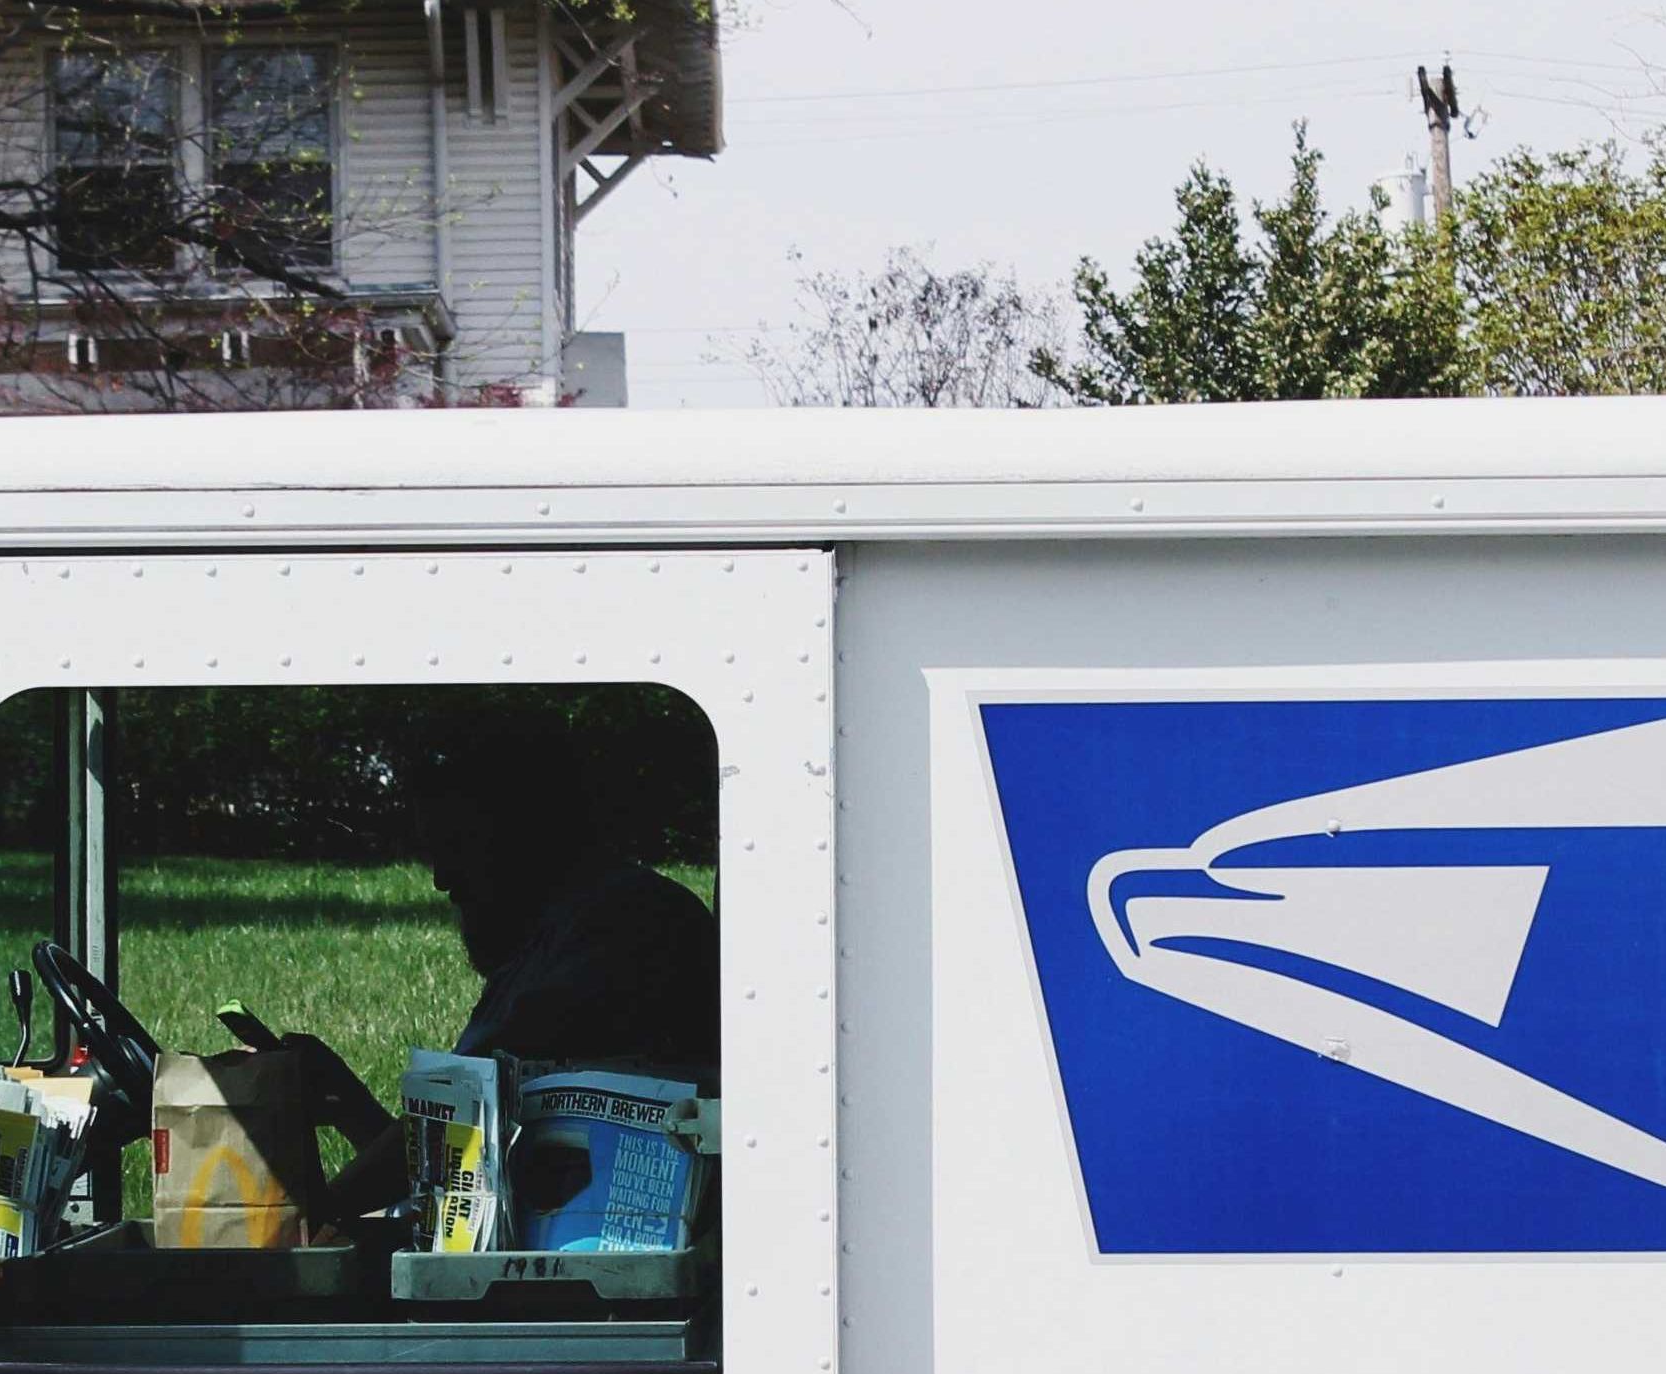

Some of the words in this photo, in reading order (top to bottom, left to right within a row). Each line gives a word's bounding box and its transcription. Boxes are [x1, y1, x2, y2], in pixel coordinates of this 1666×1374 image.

[541, 1093, 608, 1113] NORTHERN
[611, 1099, 666, 1125] BREWER
[619, 1133, 643, 1153] THIS
[646, 1140, 658, 1156] IS
[614, 1148, 680, 1181] MOMENT
[609, 1184, 650, 1209] WAITING
[651, 1194, 671, 1214] FOR
[648, 1180, 675, 1198] BEEN
[604, 1201, 644, 1230] OPEN
[601, 1223, 623, 1244] FOR
[623, 1230, 632, 1245] A
